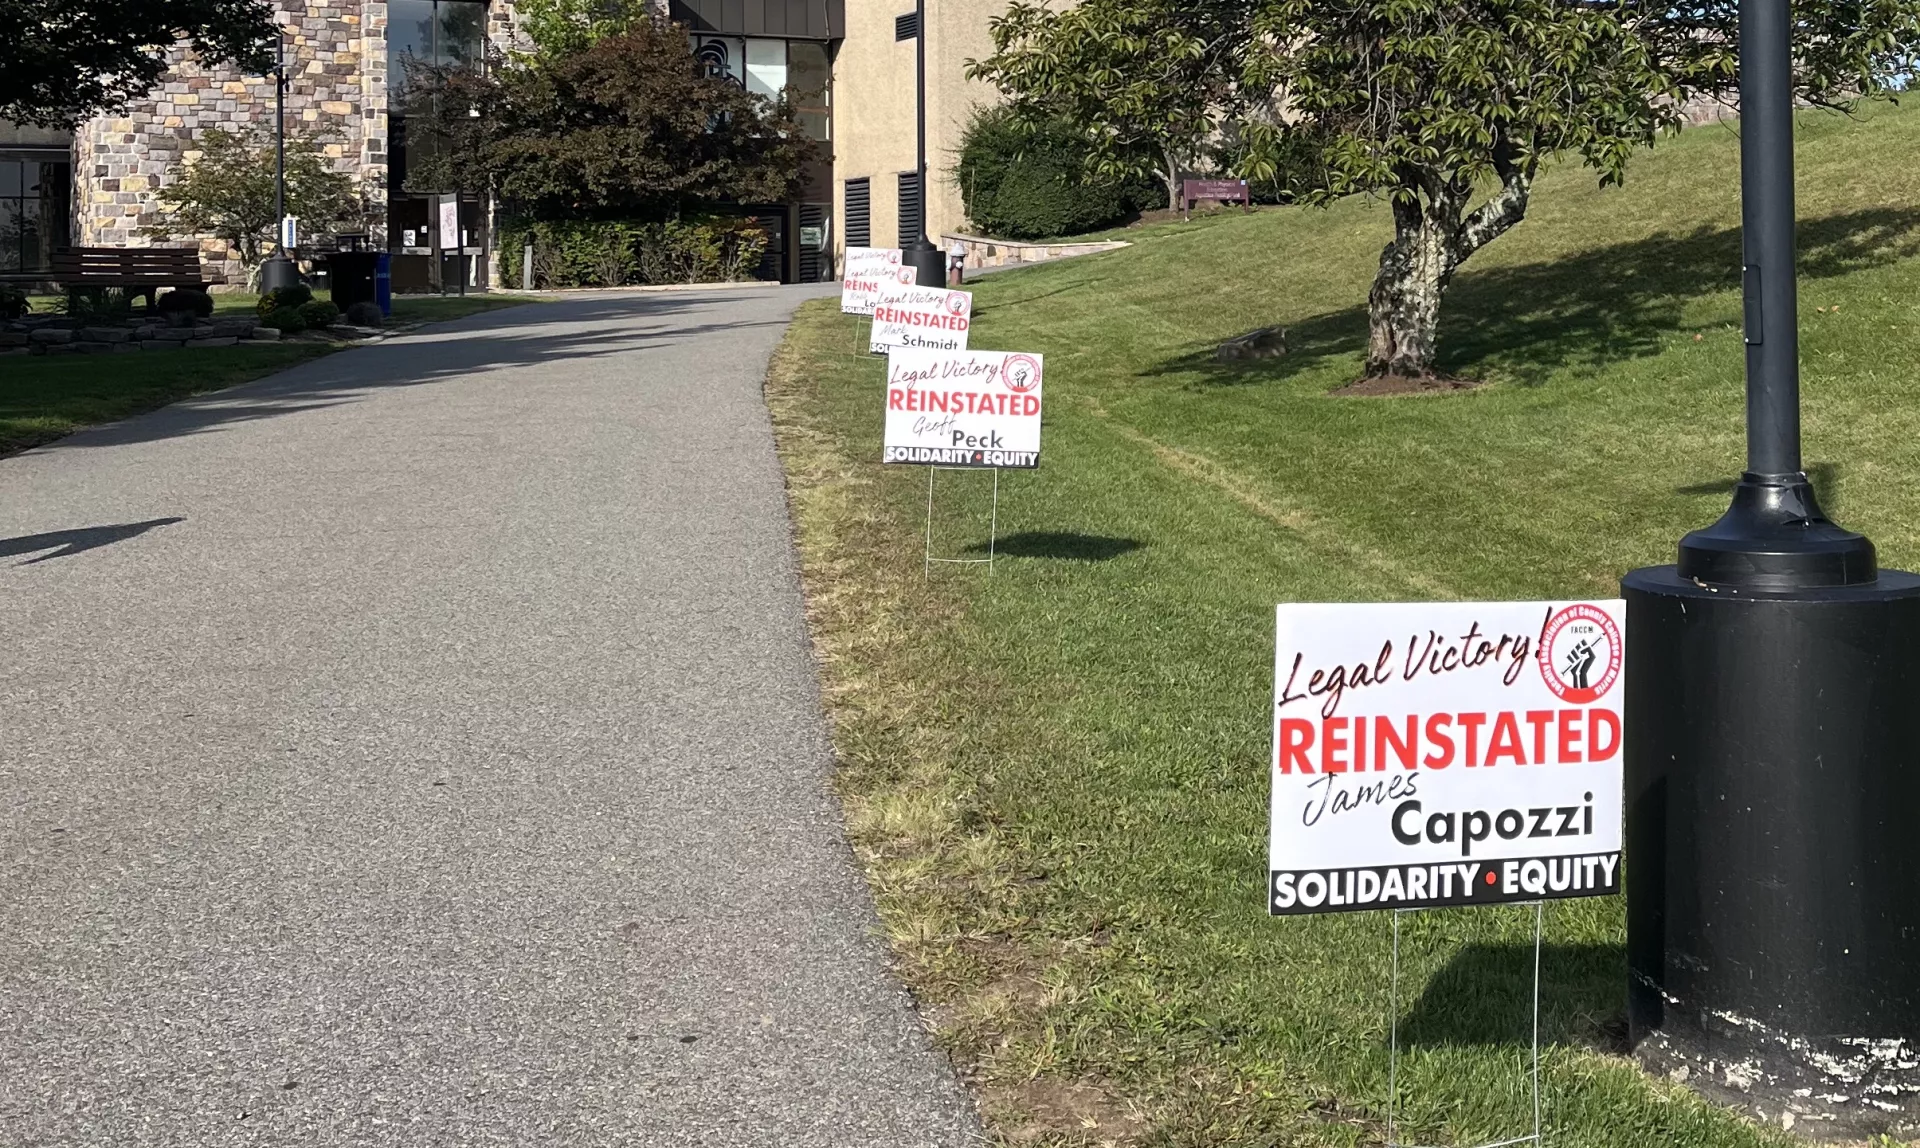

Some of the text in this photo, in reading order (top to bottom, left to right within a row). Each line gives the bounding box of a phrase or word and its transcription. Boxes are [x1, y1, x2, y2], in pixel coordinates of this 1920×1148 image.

[877, 291, 905, 309] Legal
[875, 307, 968, 331] REINSTATED
[879, 324, 908, 336] Mark
[902, 334, 959, 351] Schmidt
[890, 363, 937, 390] Legal
[942, 354, 1009, 384] Victory!
[889, 389, 1040, 416] REINSTATED
[913, 411, 958, 436] Geoff
[952, 430, 1004, 449] Peck
[886, 446, 1038, 466] SOLIDARITY EQUITY
[1278, 606, 1553, 719] Legal Victory!
[1279, 709, 1621, 775] REINSTATED
[1303, 771, 1420, 827] James
[1391, 791, 1592, 856] Capozzi
[1275, 854, 1619, 909] SOLIDARITY EQUITY
